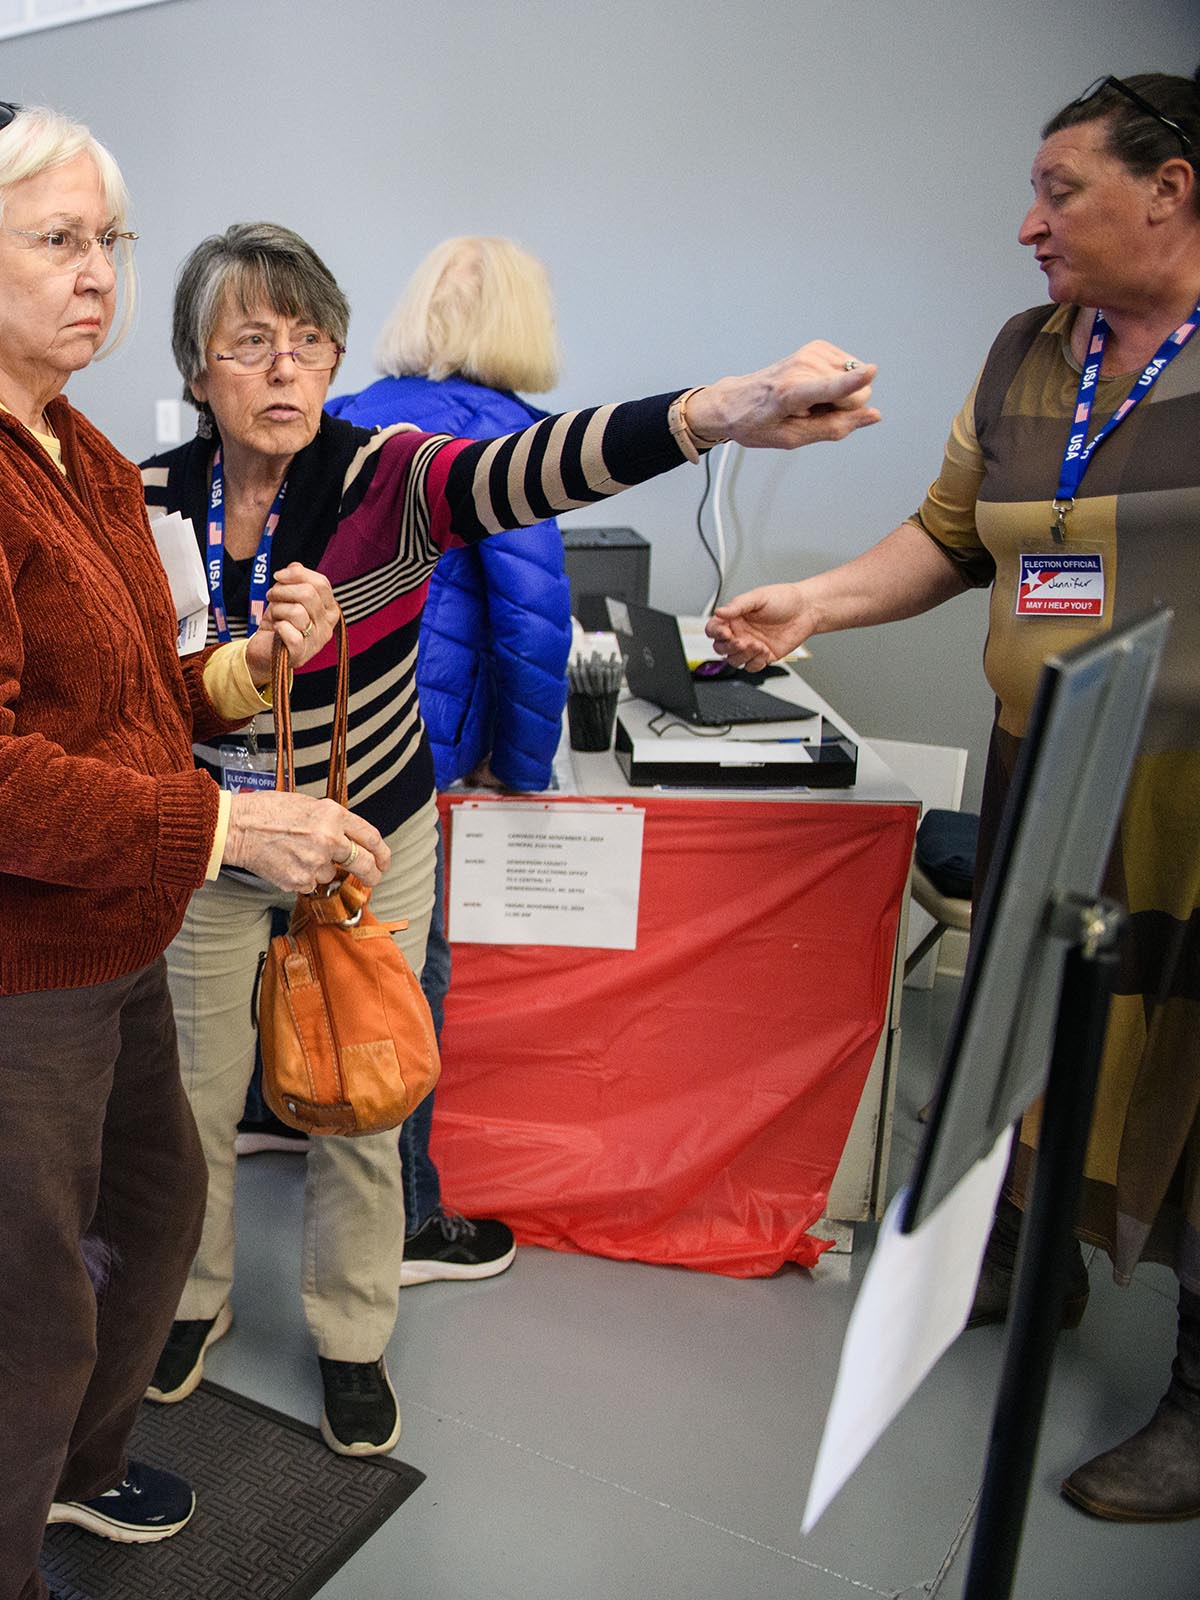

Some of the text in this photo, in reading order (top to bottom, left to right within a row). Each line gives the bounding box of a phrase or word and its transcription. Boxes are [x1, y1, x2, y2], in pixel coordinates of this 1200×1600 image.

[1082, 364, 1098, 390] USA
[1138, 358, 1167, 386] USA
[1065, 433, 1084, 461] USA
[211, 478, 223, 509] USA
[209, 559, 221, 591] USA
[253, 553, 268, 584] USA
[1024, 560, 1099, 569] ELECTION OFFICIAL
[1048, 577, 1093, 589] Jennifer
[1070, 602, 1093, 610] YOU?
[227, 774, 257, 785] ELECTION
